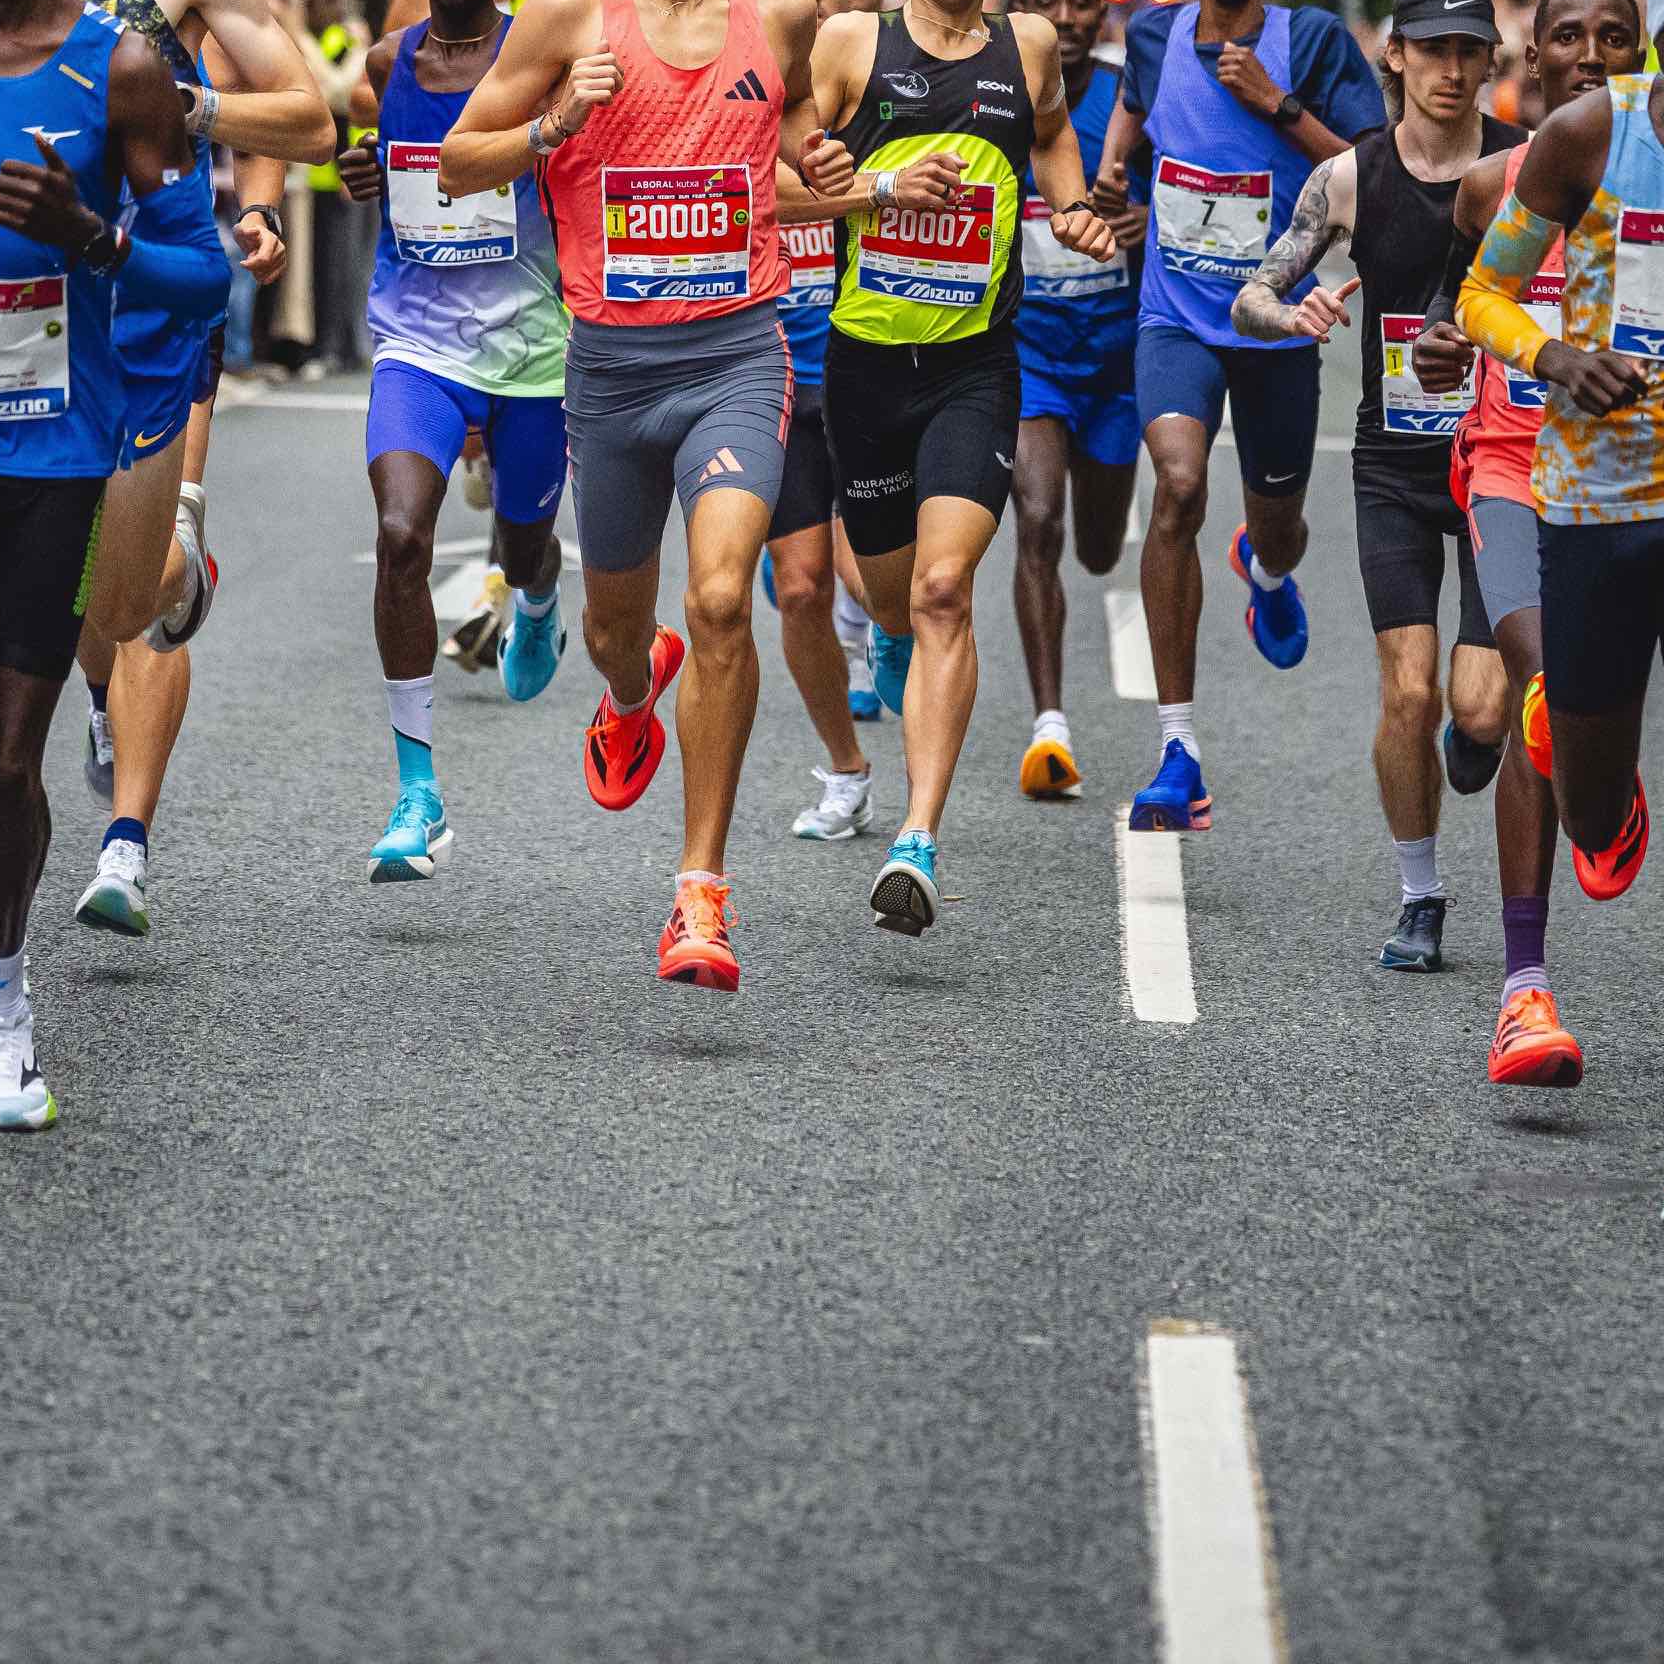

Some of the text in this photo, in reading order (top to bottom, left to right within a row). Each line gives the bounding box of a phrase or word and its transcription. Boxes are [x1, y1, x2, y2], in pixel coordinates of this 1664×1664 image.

[406, 154, 439, 162] LABORAL
[631, 180, 699, 189] LABORAL kutxa
[628, 202, 728, 239] 20003
[1202, 199, 1216, 226] 7
[613, 213, 618, 231] 1
[880, 207, 976, 247] 20007
[1392, 354, 1397, 370] 1
[853, 470, 910, 489] DURANGO
[846, 487, 880, 499] KIROL
